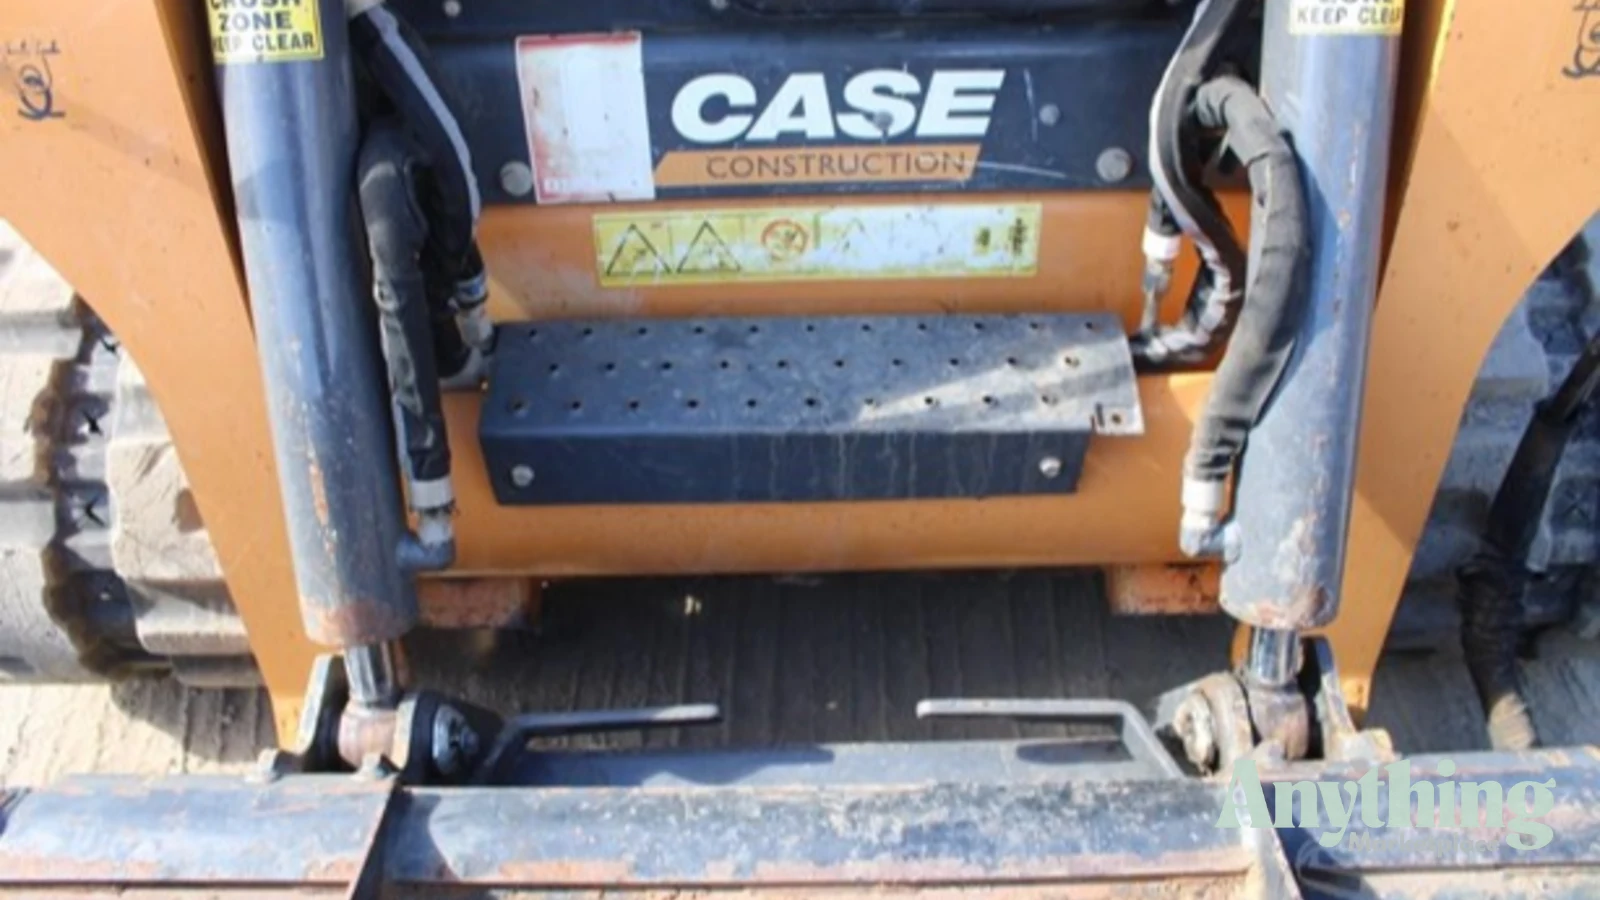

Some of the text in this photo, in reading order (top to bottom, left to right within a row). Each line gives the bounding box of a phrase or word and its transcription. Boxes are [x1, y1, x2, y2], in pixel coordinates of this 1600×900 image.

[218, 11, 293, 32] ZONE
[1297, 6, 1348, 24] KEEP
[253, 31, 315, 52] CLEAR
[671, 69, 1006, 143] CASE
[705, 150, 966, 180] CONSTRUCTION
